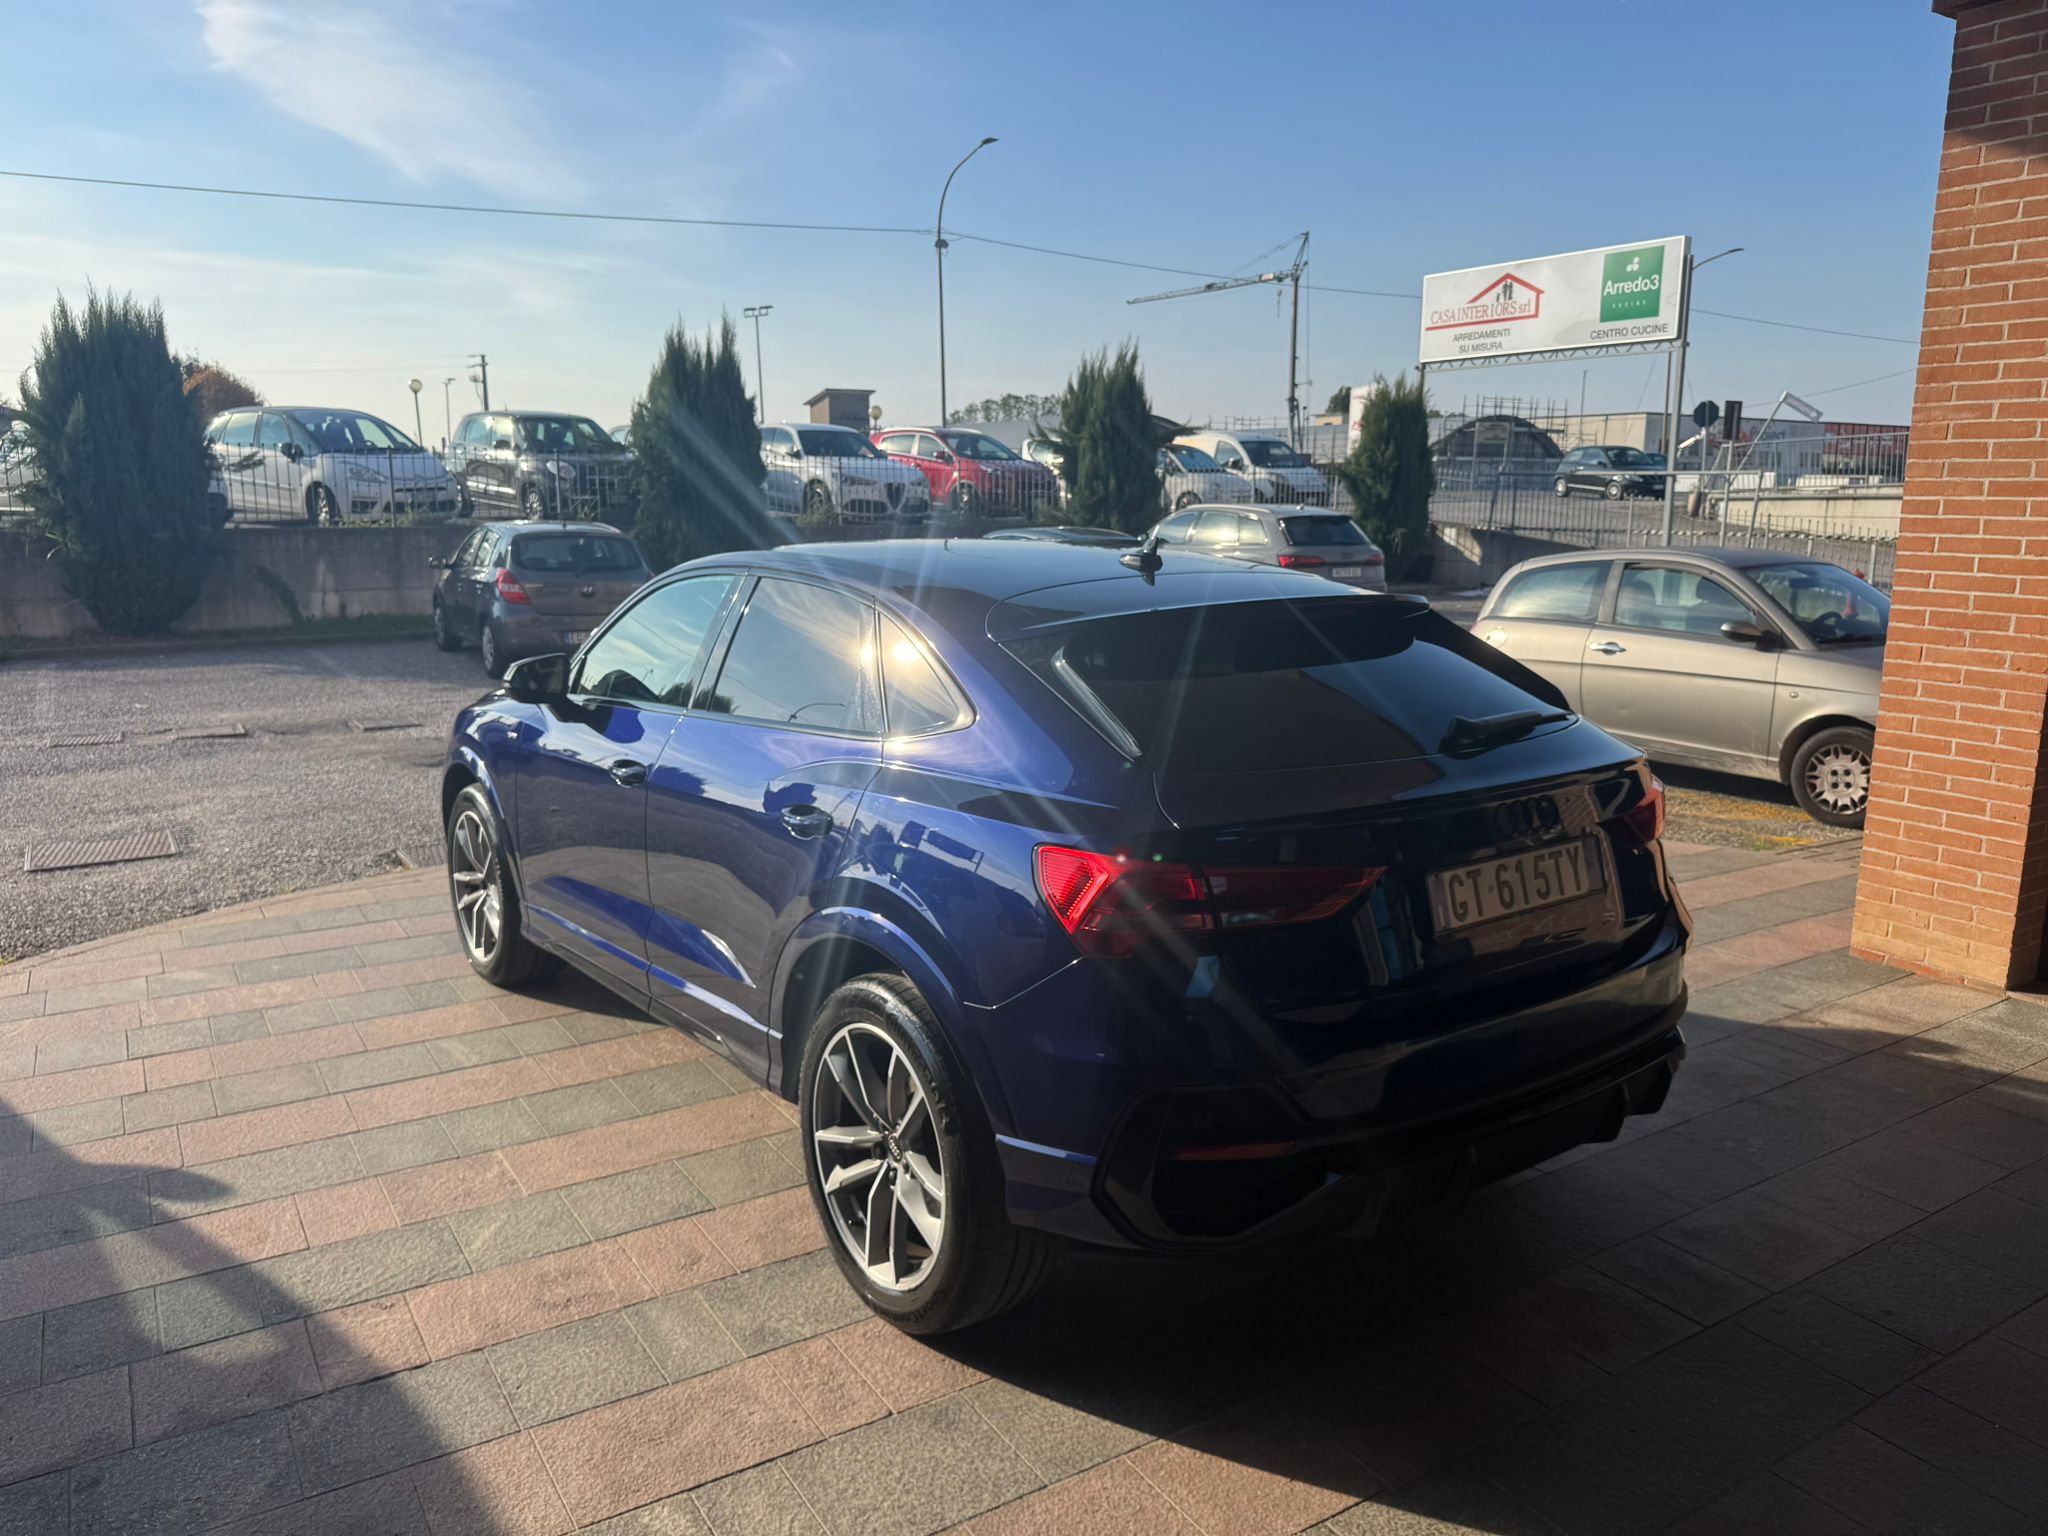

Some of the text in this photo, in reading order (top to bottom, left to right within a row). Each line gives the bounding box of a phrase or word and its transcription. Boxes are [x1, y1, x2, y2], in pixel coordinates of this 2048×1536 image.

[1603, 274, 1659, 296] Arredo3
[1453, 328, 1511, 343] ARREDAMENTI
[1590, 323, 1669, 340] CENTRO CUCINE
[1458, 341, 1503, 354] SU MISURA
